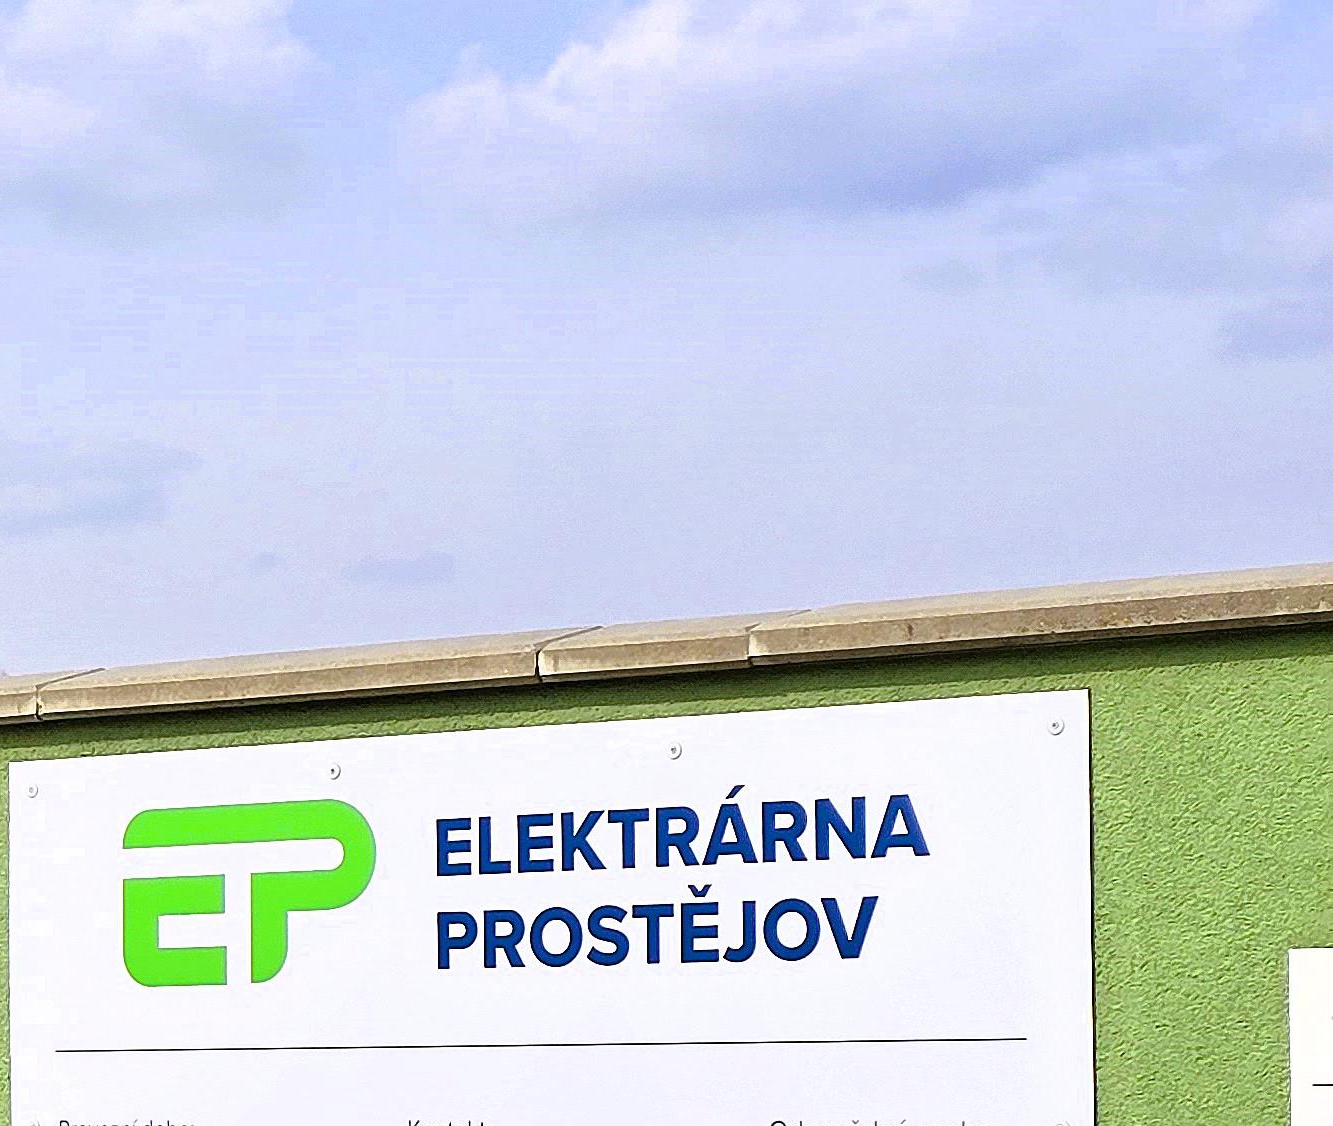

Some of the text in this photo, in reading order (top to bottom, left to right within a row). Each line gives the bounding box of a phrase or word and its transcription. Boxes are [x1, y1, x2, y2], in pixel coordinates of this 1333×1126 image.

[436, 785, 930, 876] ELEKTRÁRNA
[122, 799, 376, 987] EP
[437, 884, 879, 969] PROSTĚJOV
